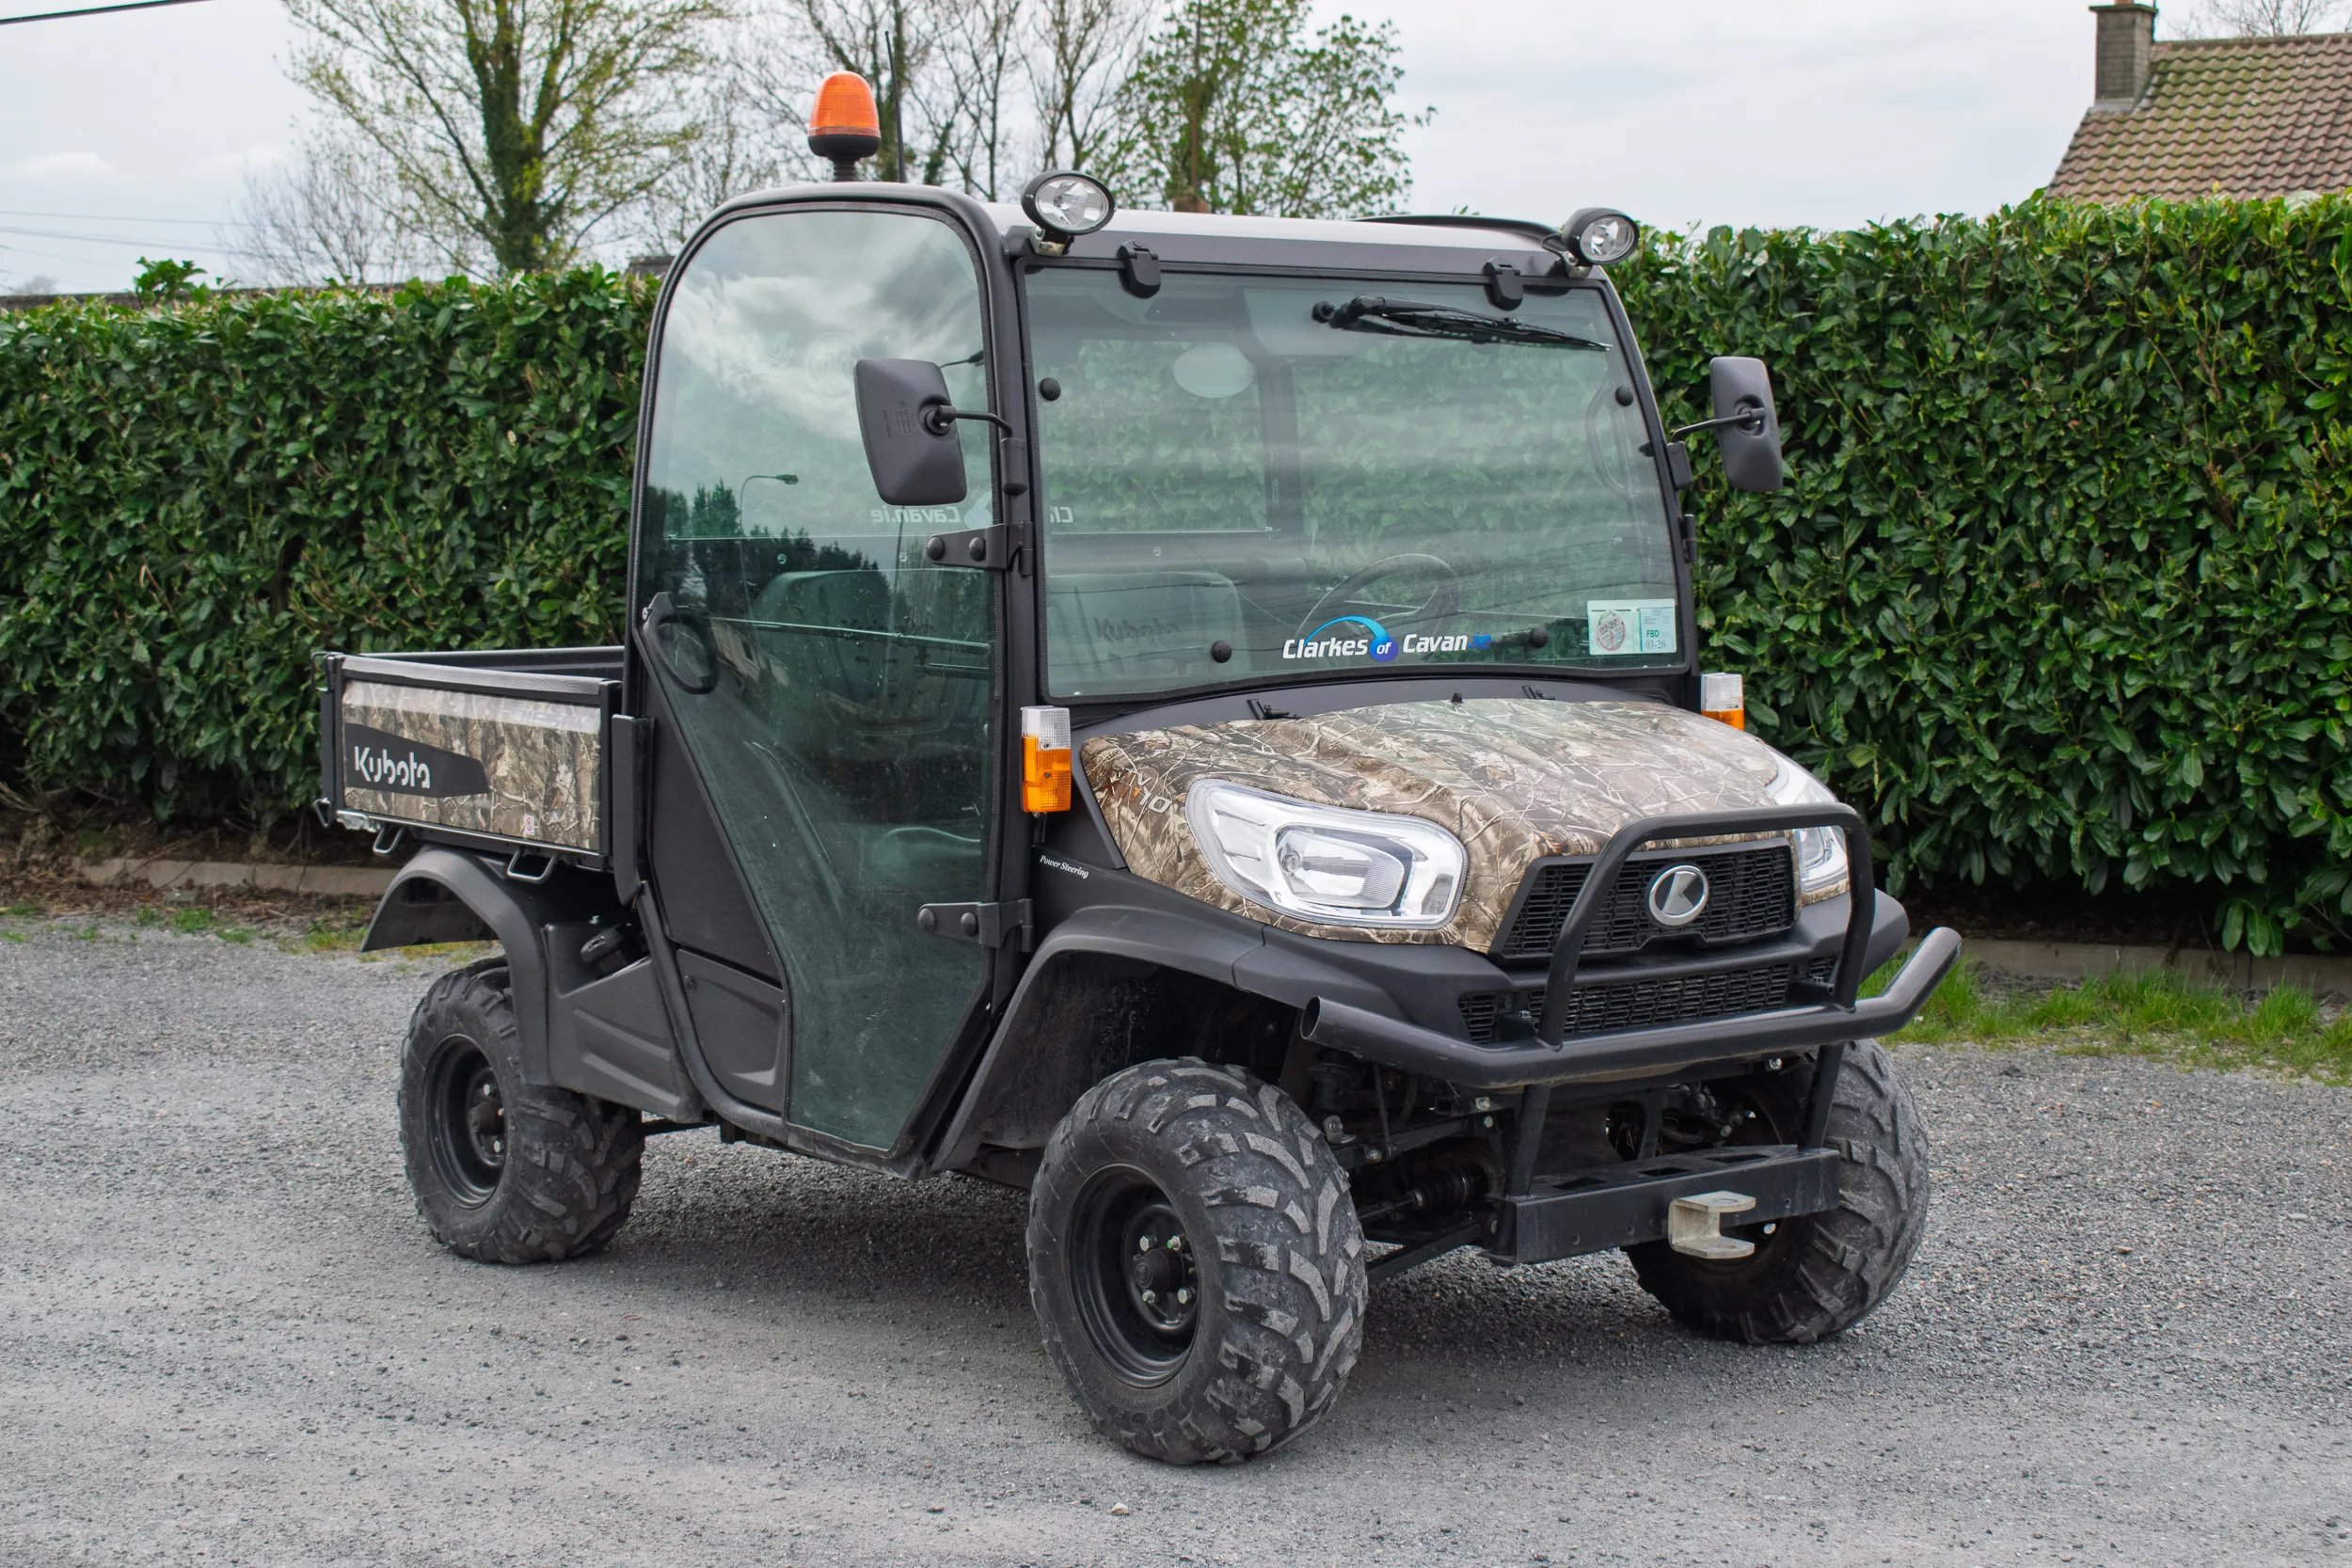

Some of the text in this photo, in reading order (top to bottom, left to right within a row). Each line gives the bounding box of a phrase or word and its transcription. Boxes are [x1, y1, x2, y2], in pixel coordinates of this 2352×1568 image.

[1282, 632, 1492, 659] Clarkes of Cavan.ie
[1645, 640, 1666, 650] 03-26
[1646, 629, 1660, 638] FBD
[355, 745, 431, 789] Kubota
[1040, 855, 1089, 879] Power Steering
